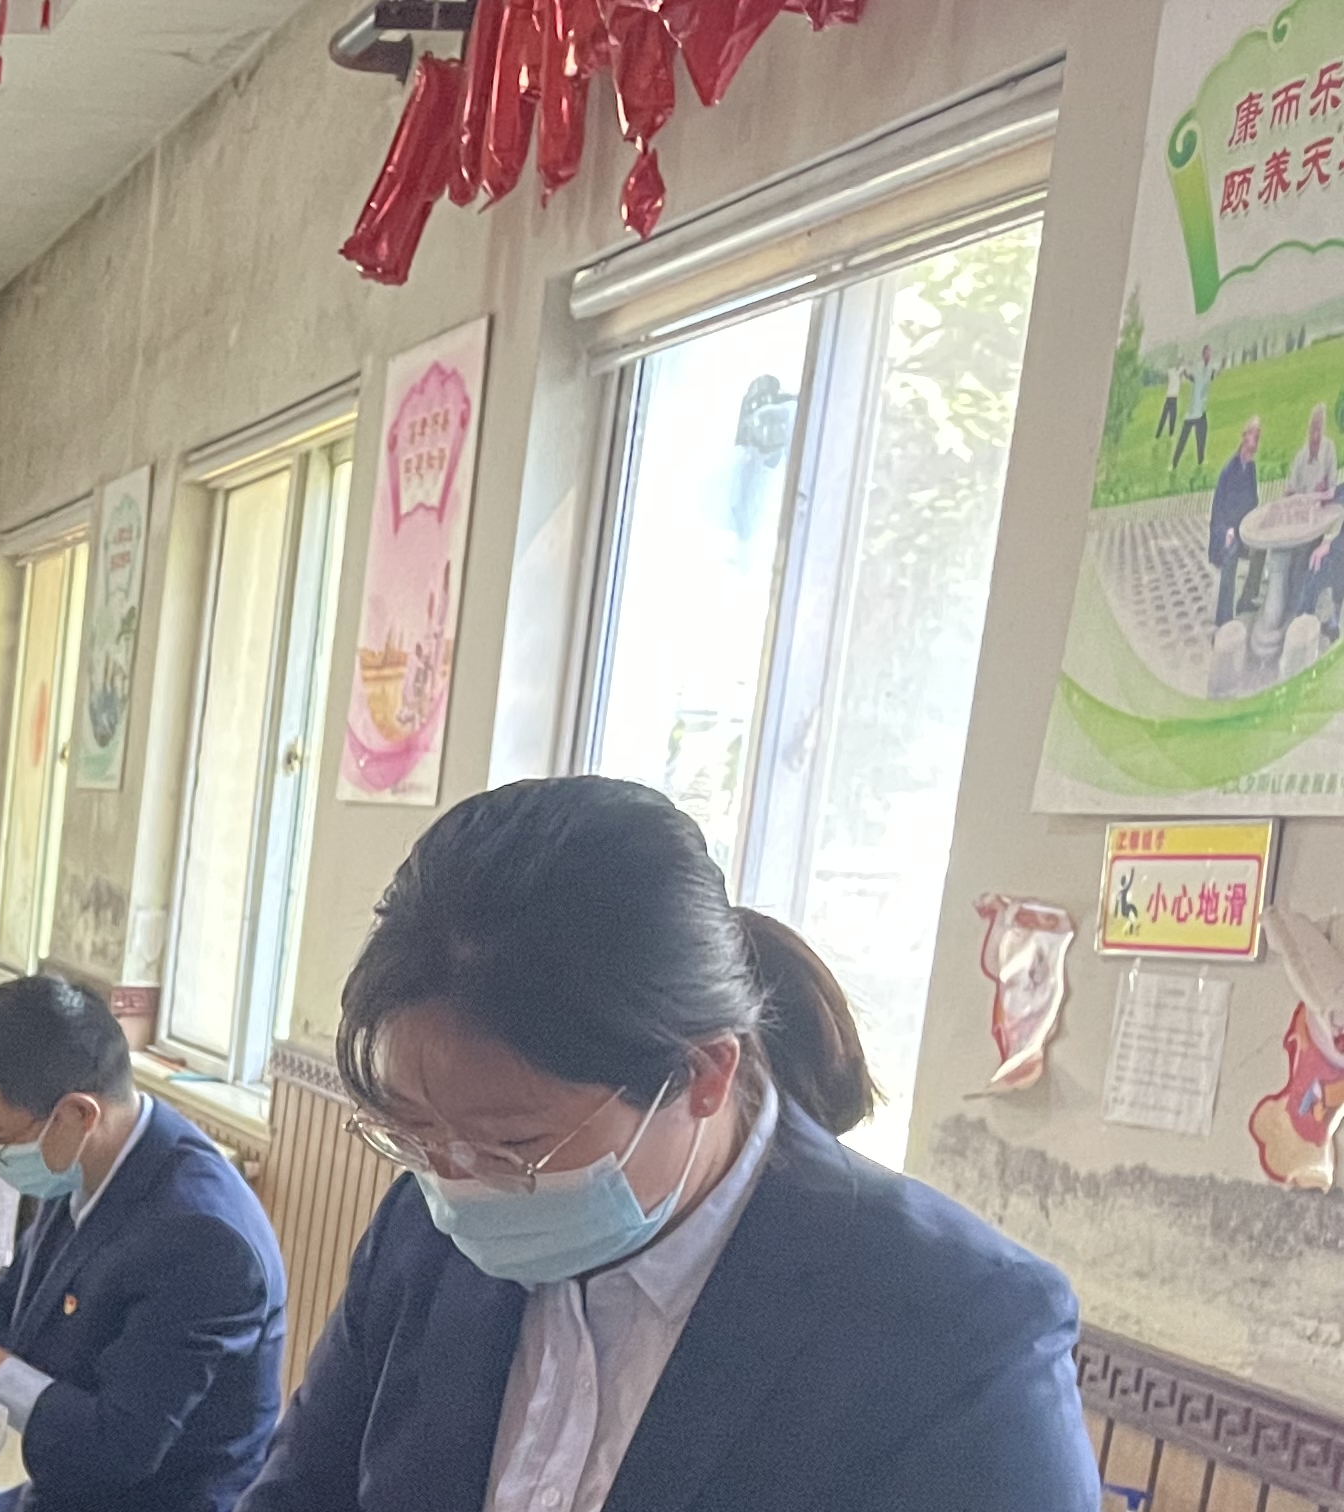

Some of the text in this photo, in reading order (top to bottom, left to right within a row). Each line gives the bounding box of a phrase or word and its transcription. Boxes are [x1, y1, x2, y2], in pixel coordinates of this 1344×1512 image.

[1220, 137, 1344, 216] 颐养天
[1146, 882, 1247, 926] 小心地滑
